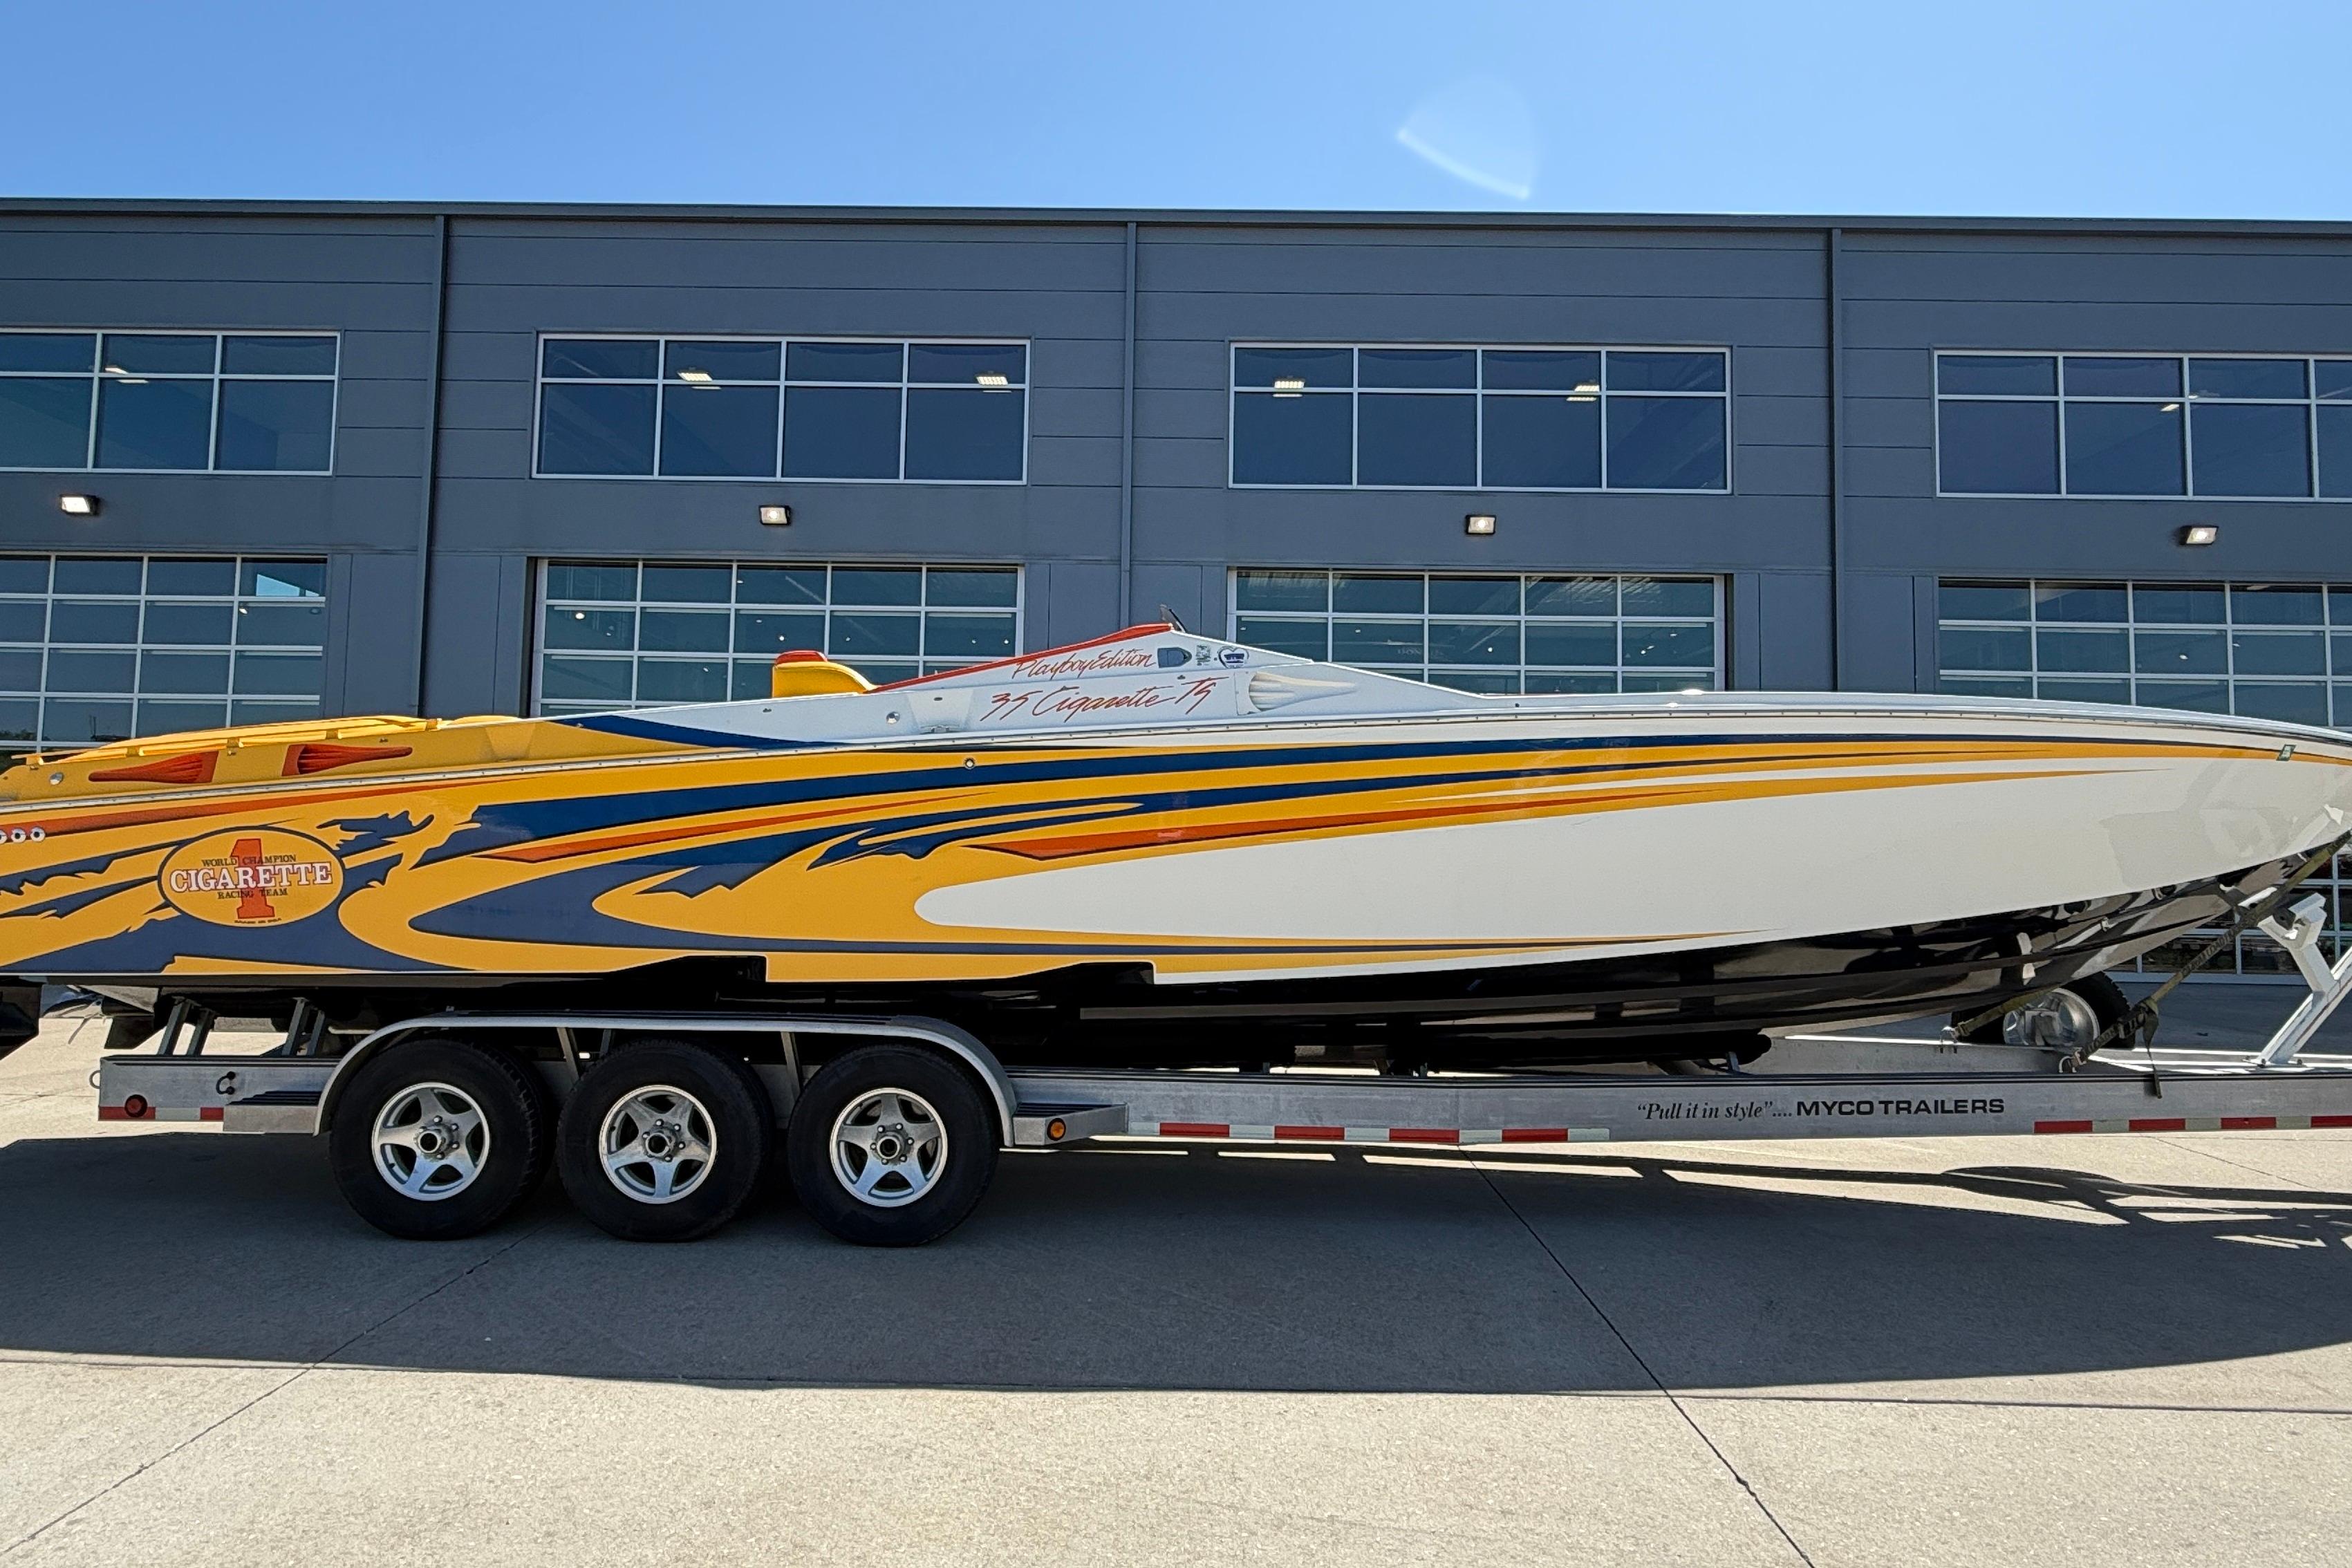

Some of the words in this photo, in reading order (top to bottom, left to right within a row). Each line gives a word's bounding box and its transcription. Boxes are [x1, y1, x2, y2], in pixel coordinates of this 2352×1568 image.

[1032, 685, 1177, 722] Cigarette
[201, 857, 237, 866] WORLD
[242, 854, 296, 864] CHAMPION
[169, 861, 333, 893] CIGARETTE
[217, 890, 254, 899] RACING
[259, 888, 288, 897] TEAM
[1686, 1103, 1697, 1119] it
[1702, 1102, 1719, 1119] in
[1798, 1100, 1872, 1116] MYCO
[1878, 1099, 2004, 1114] TRAILERS
